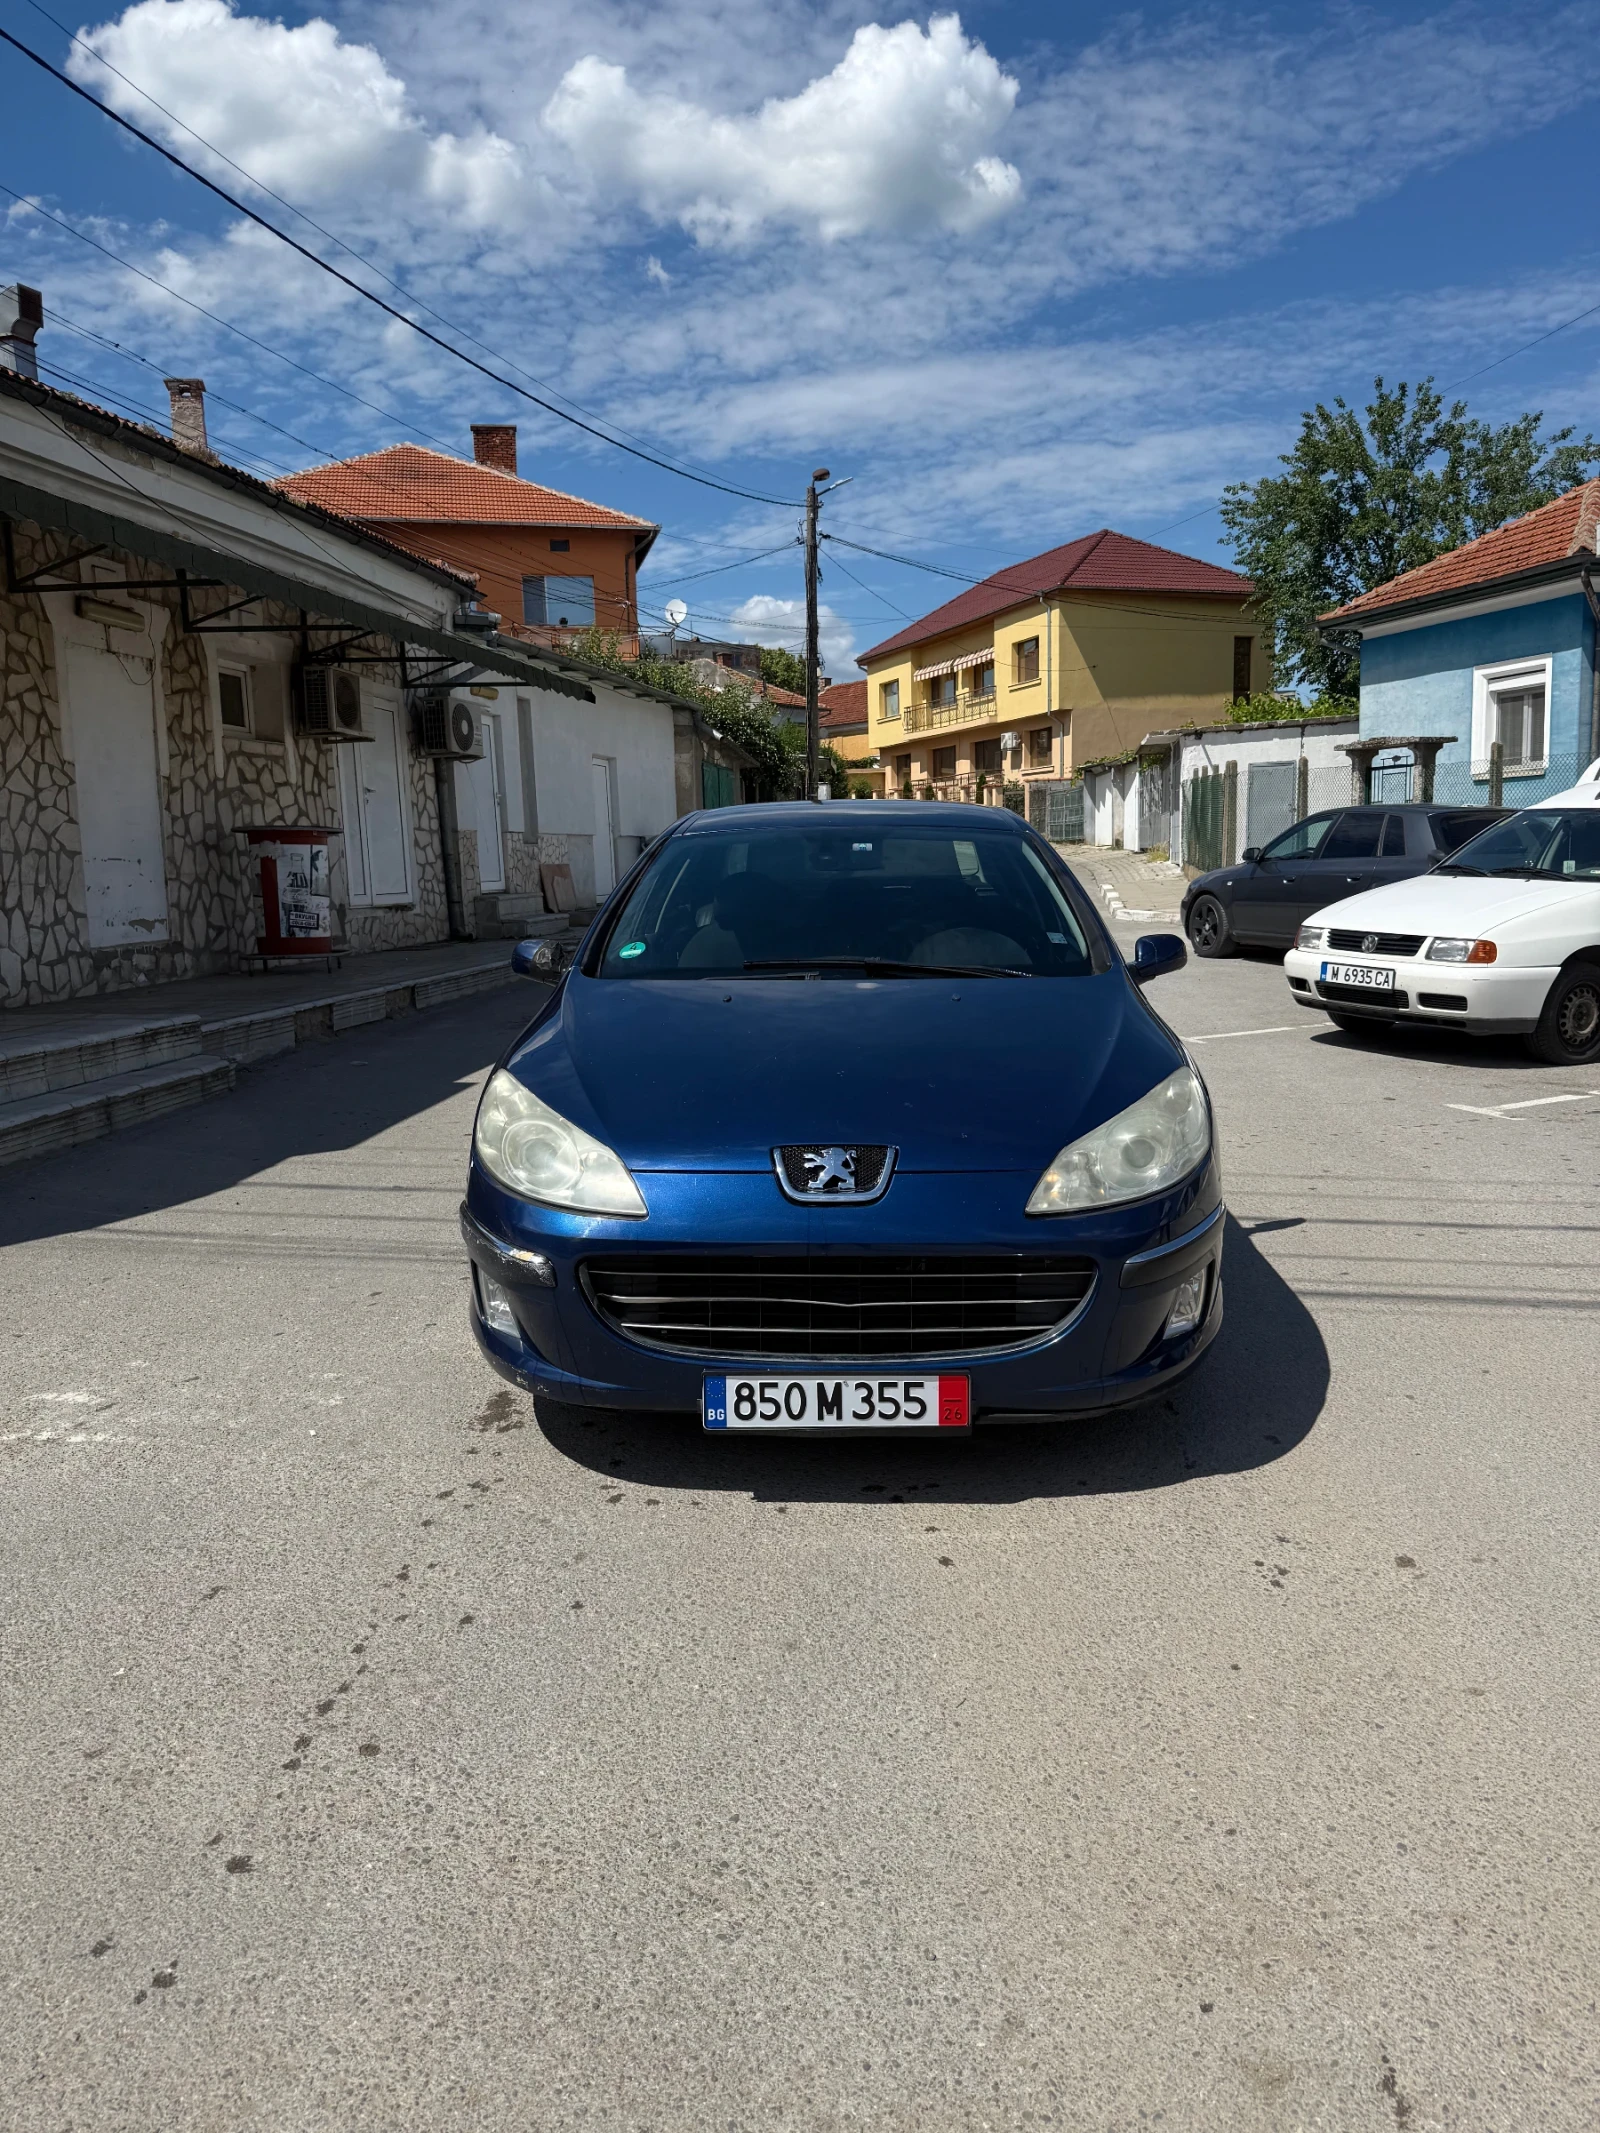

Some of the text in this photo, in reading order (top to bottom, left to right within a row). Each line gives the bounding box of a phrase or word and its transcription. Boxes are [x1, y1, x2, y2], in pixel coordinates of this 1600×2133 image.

[1331, 966, 1390, 987] M 6935 CA
[733, 1381, 927, 1421] 850 M 355
[708, 1408, 725, 1420] BG
[943, 1407, 962, 1420] 26
